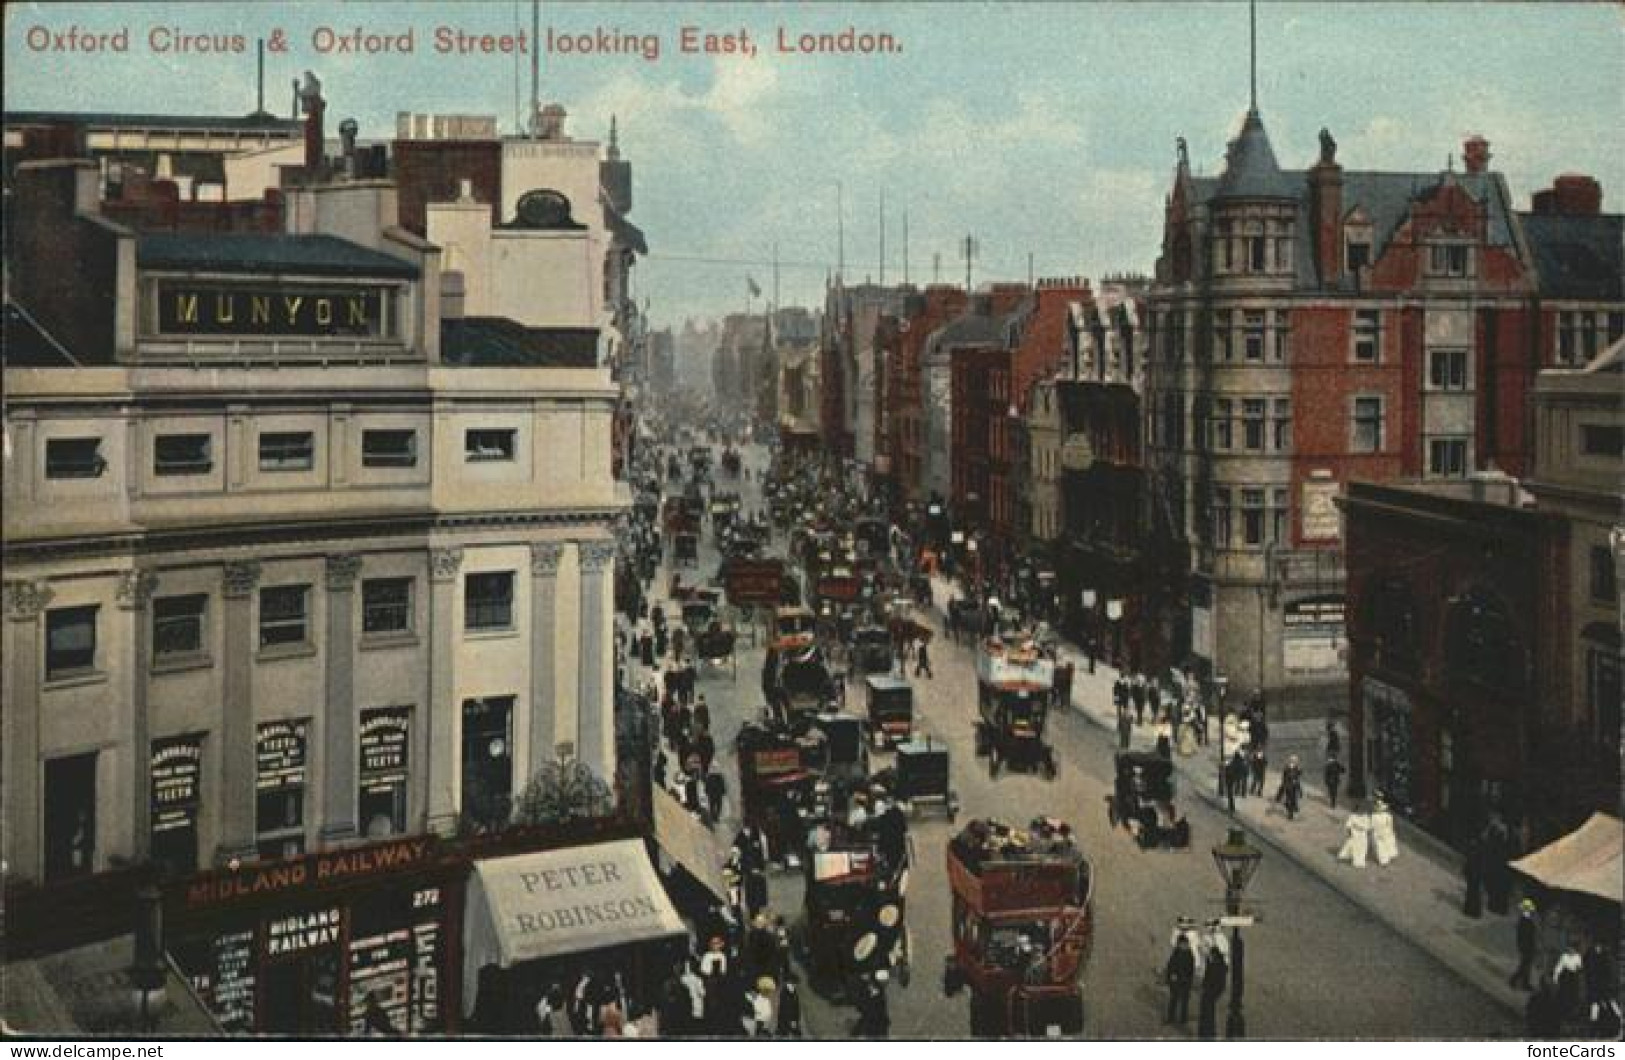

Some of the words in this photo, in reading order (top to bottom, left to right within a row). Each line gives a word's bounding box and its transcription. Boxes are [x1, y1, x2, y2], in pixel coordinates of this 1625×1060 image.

[177, 295, 369, 326] MUNYON
[187, 864, 306, 904] MIDLAND
[519, 861, 622, 893] PETER
[269, 909, 340, 935] MIDLAND
[517, 895, 656, 933] ROBINSON
[268, 926, 339, 955] RAILWAY
